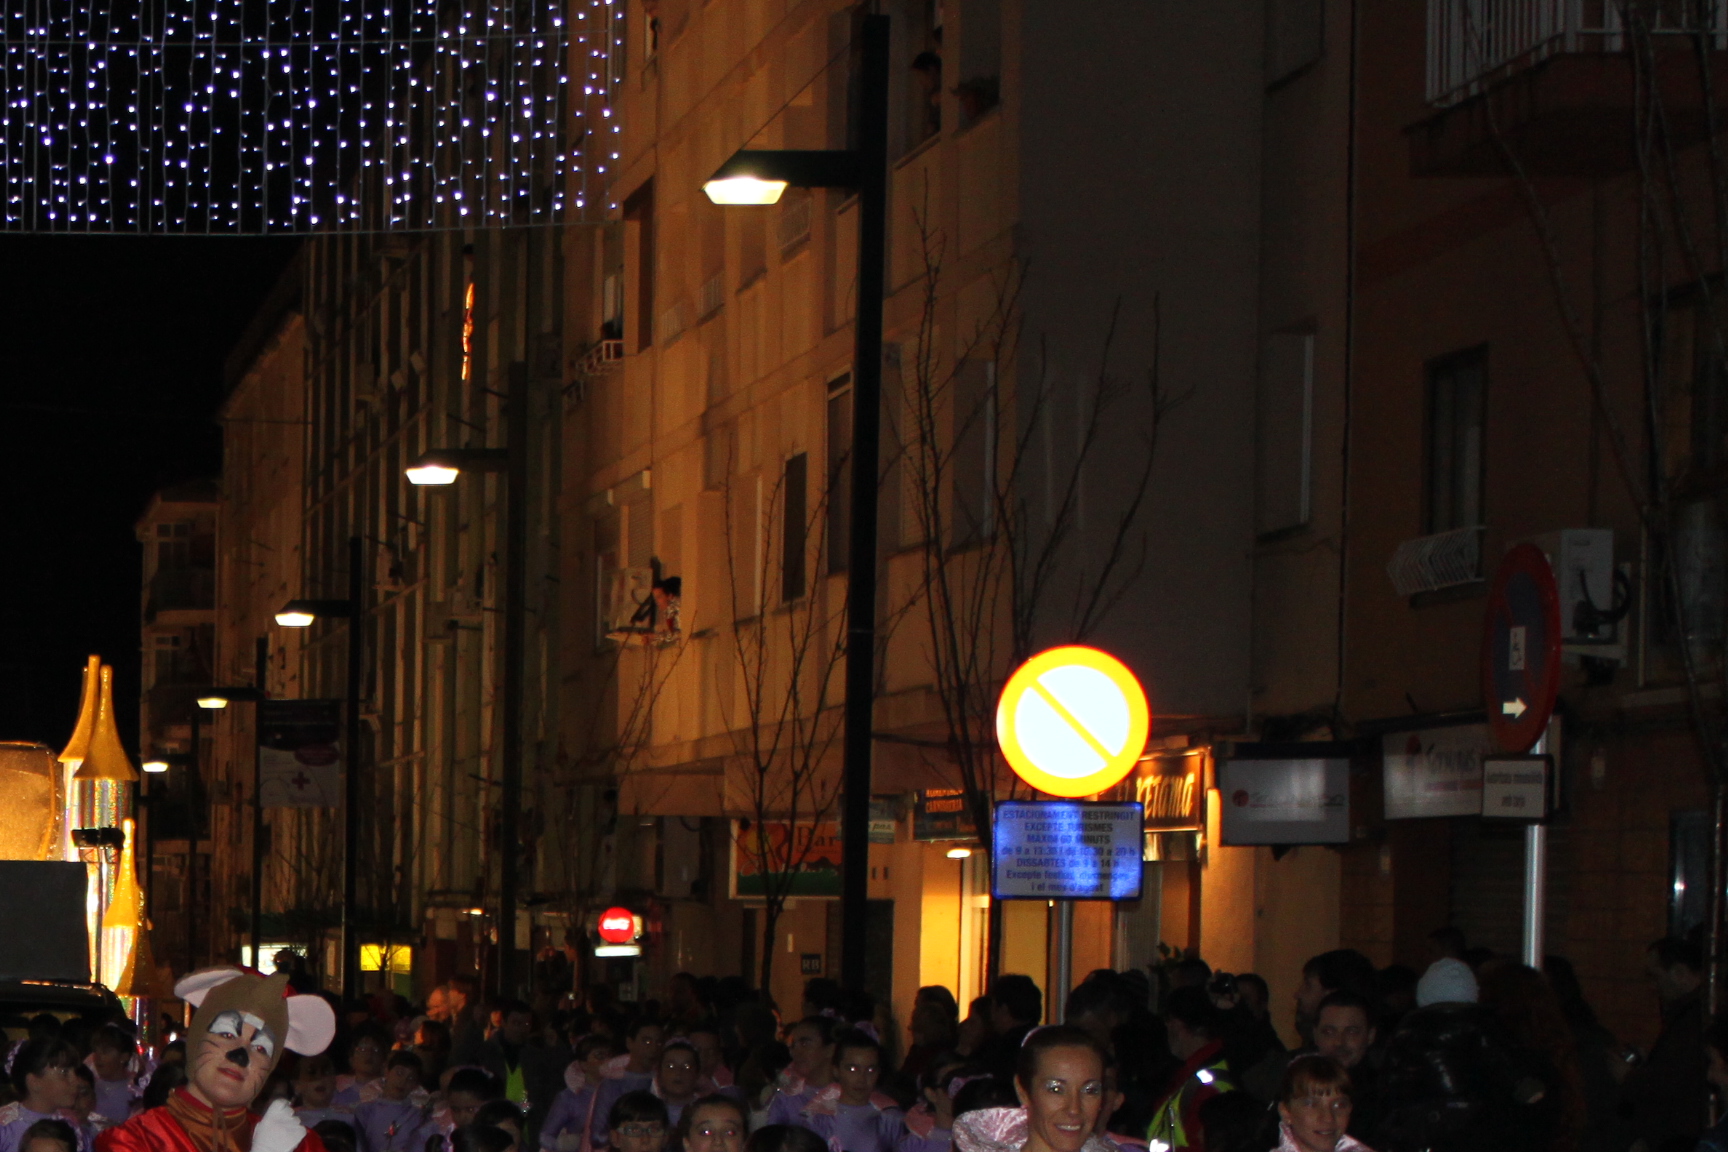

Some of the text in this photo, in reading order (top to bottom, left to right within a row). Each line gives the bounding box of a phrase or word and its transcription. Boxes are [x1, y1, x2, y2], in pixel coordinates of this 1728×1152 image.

[1003, 810, 1134, 820] ESTACIONAMENT RESTRINGIT
[1024, 823, 1066, 832] EXCEPTE
[1016, 859, 1066, 867] DISSABTES
[1006, 870, 1042, 880] Excepte
